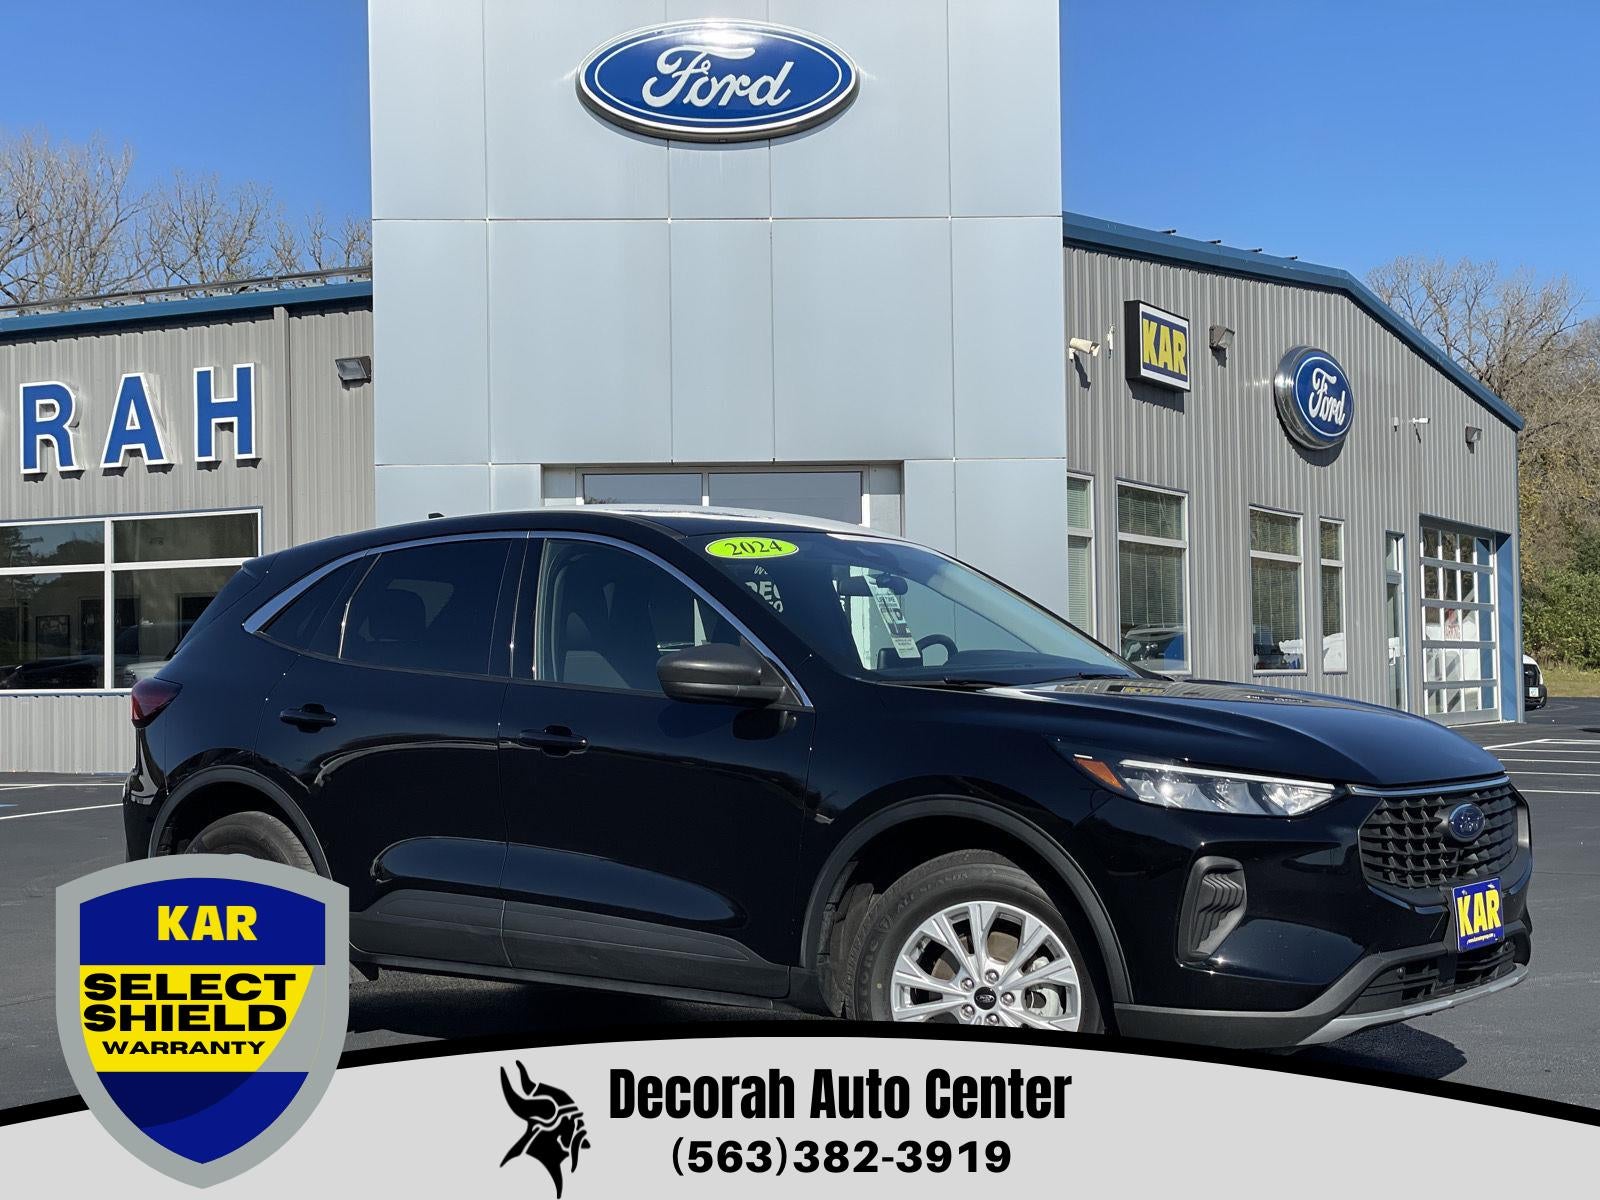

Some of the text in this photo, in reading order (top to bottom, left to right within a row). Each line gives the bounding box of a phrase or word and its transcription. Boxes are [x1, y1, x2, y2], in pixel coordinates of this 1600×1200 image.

[642, 44, 795, 107] Ford
[1142, 318, 1188, 376] KAR
[1308, 367, 1346, 426] Ford
[724, 540, 782, 556] 2024
[1457, 889, 1502, 937] KAR
